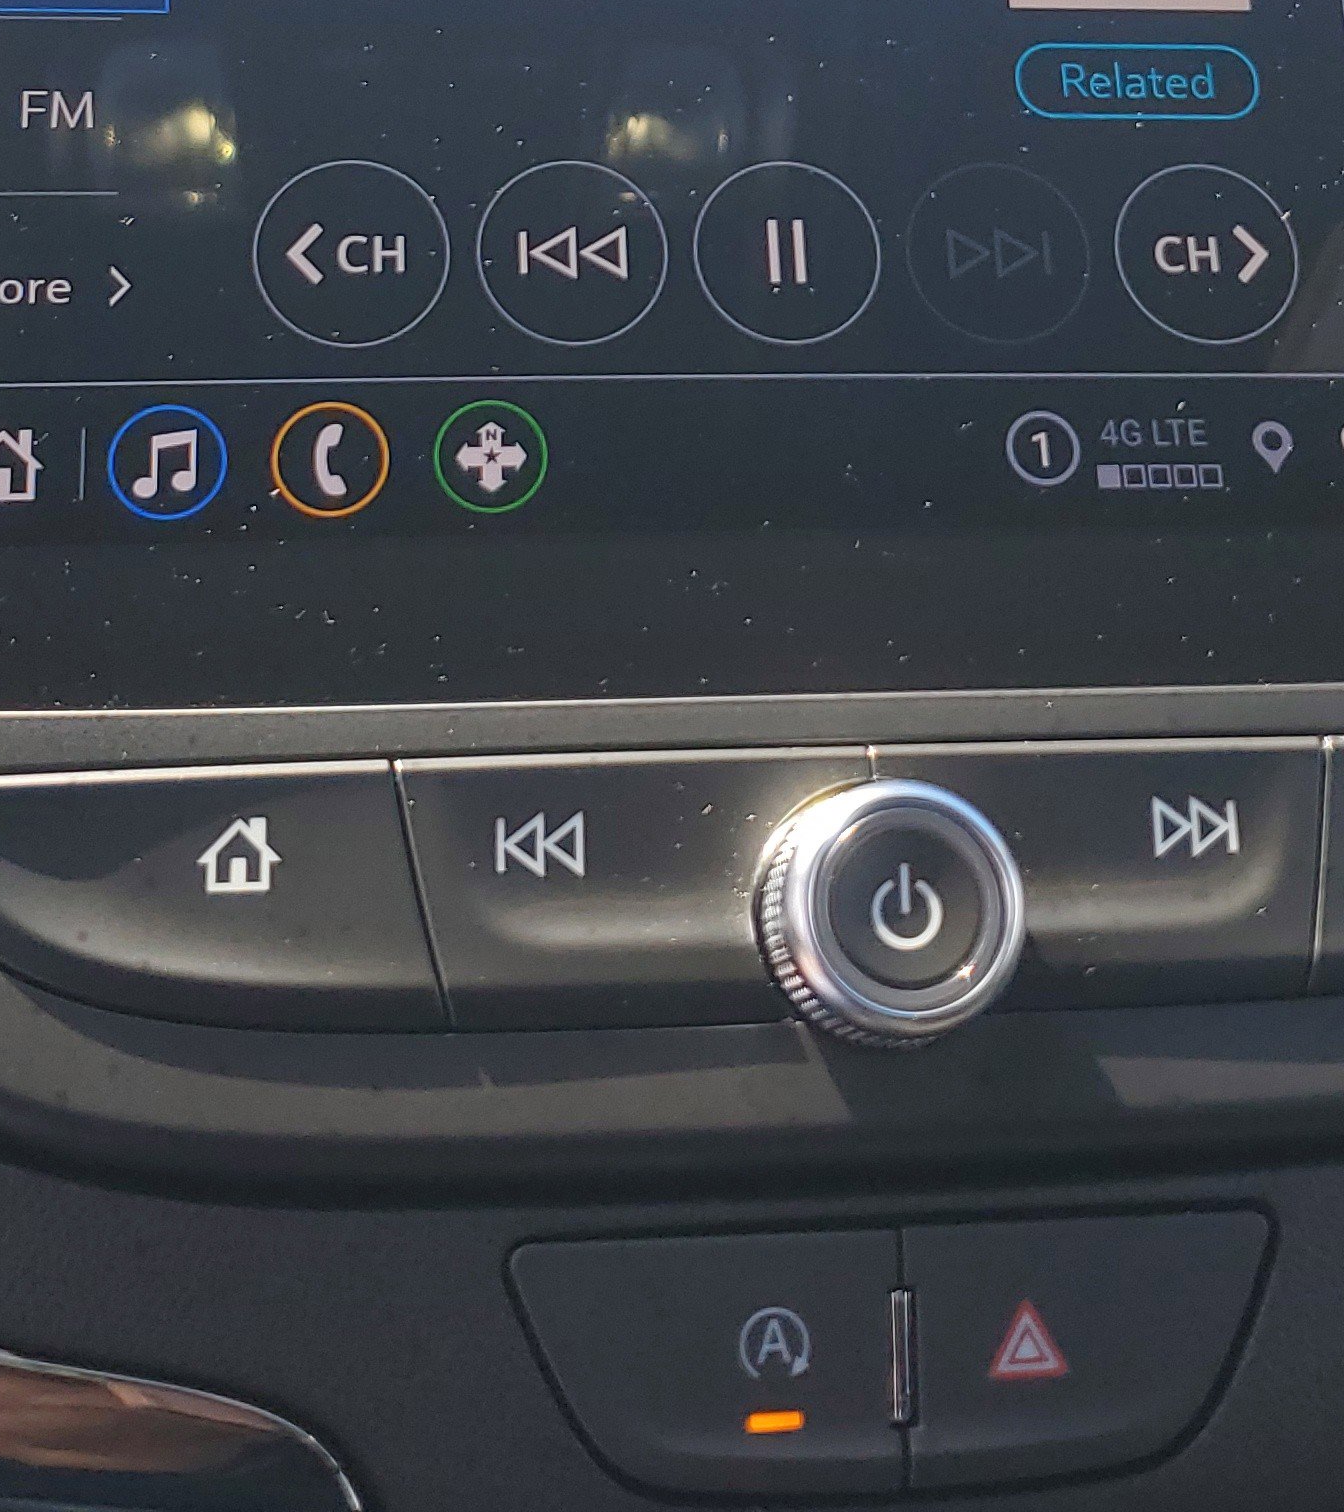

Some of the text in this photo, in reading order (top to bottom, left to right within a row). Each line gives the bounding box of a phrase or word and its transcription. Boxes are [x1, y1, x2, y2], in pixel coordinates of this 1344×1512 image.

[1062, 64, 1216, 101] Related
[20, 90, 95, 129] FM
[337, 235, 406, 274] CH
[1154, 236, 1220, 274] CH
[1030, 432, 1050, 467] 1
[1100, 419, 1208, 446] 4G LTE
[757, 1320, 792, 1364] A
